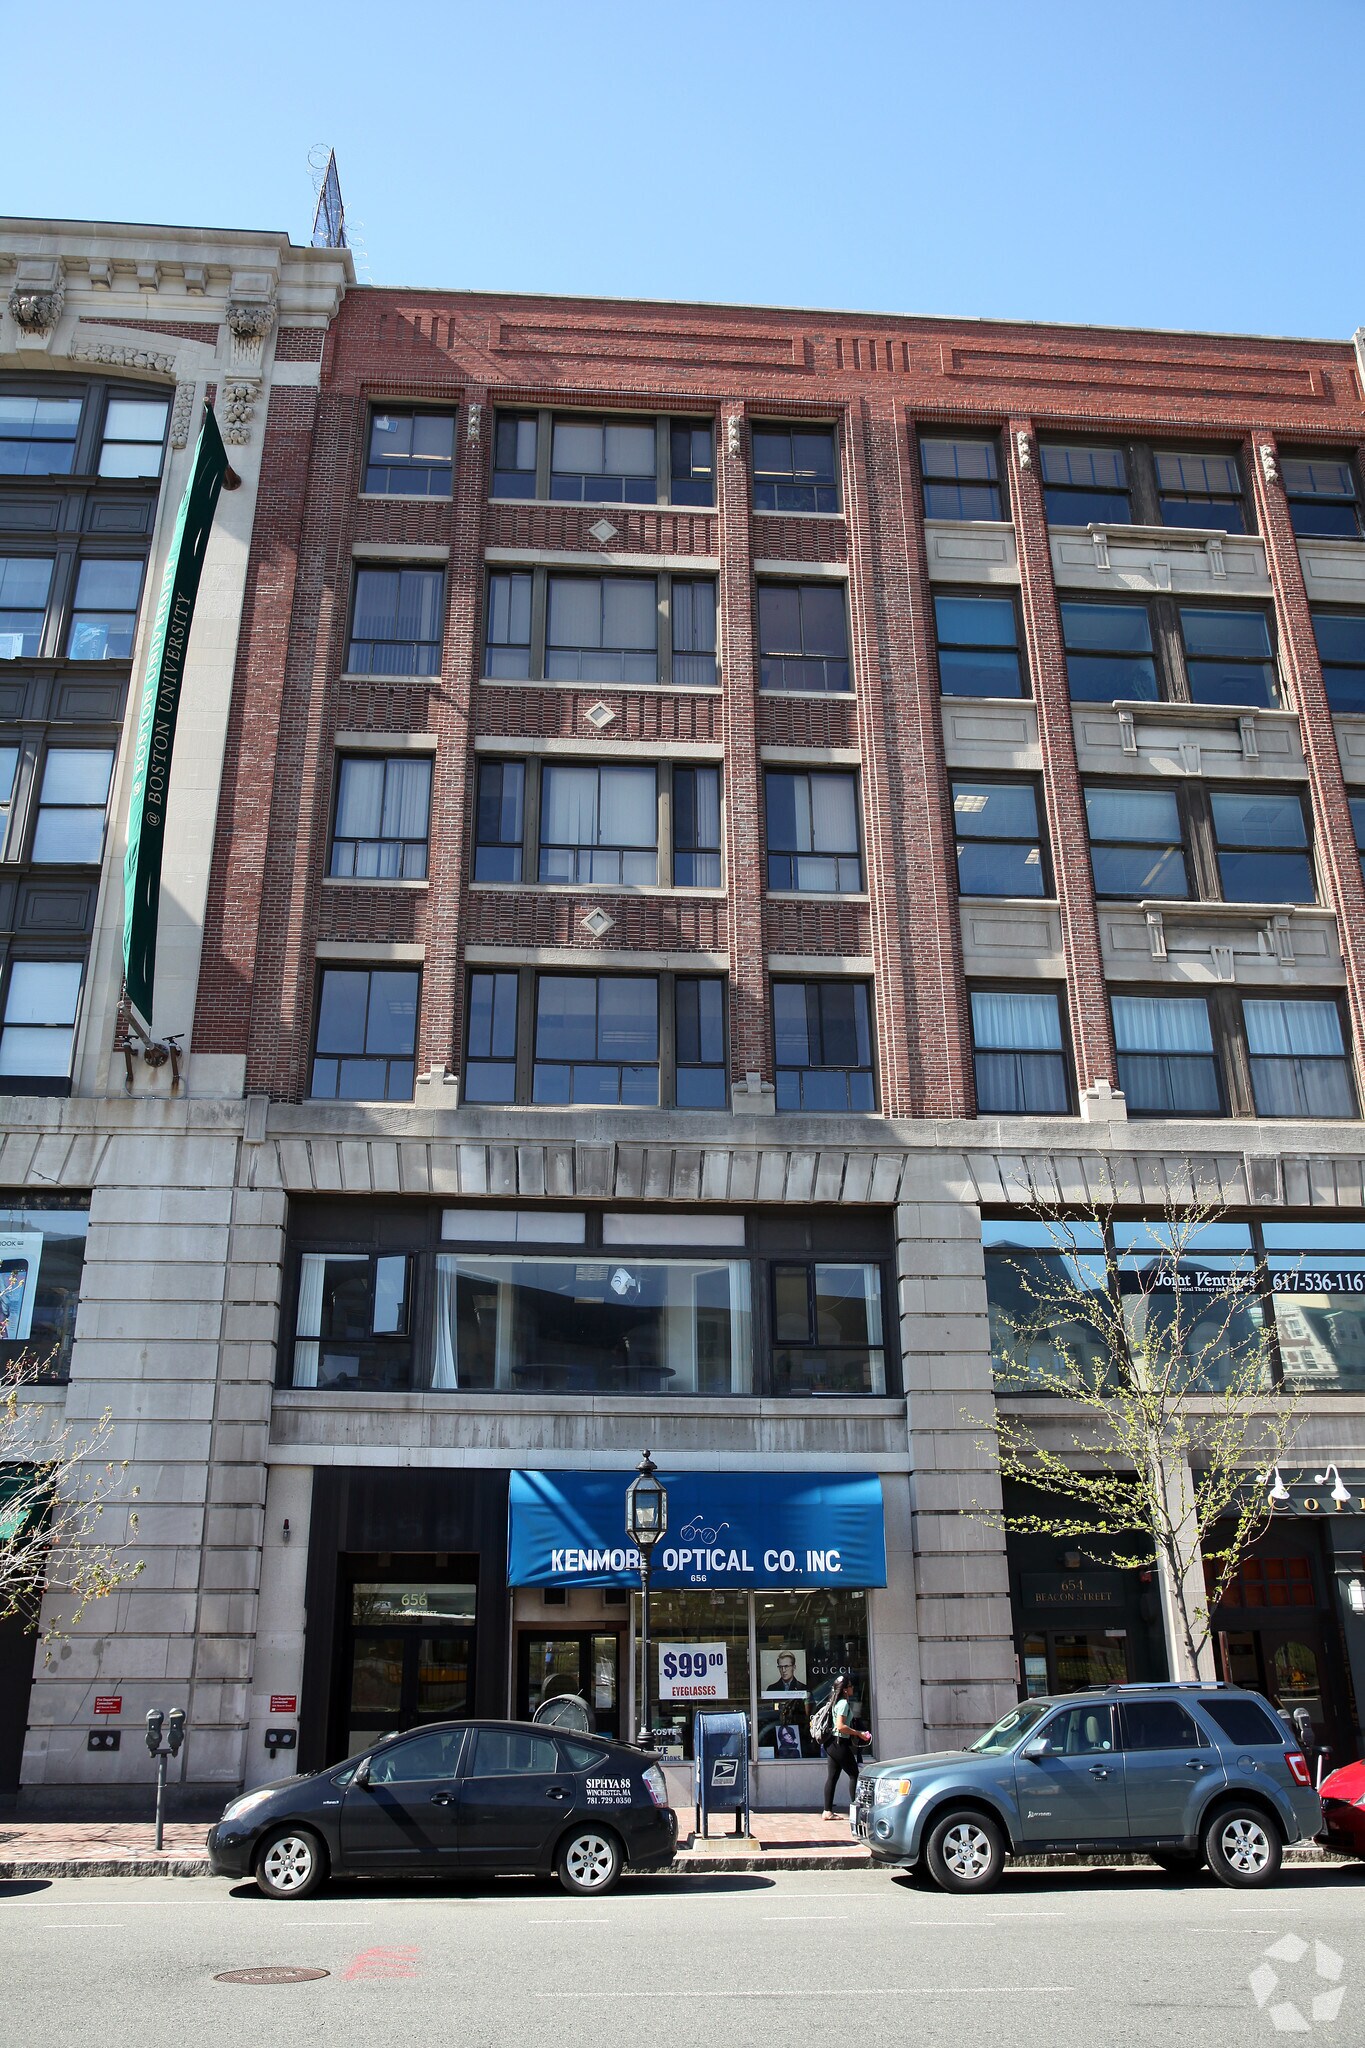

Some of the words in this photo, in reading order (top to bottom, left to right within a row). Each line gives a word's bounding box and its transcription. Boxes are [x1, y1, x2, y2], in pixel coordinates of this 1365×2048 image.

[158, 591, 190, 713] UNIVERSITY
[135, 687, 155, 776] BOSTON
[147, 719, 170, 805] BOSTON
[146, 811, 160, 826] @
[1155, 1271, 1191, 1286] Joint
[1195, 1271, 1256, 1286] Ventures
[551, 1549, 646, 1571] KENMOR
[662, 1549, 754, 1571] OPTICAL
[764, 1550, 803, 1573] CO.,
[806, 1550, 843, 1572] INC.
[690, 1574, 707, 1582] 656
[1061, 1580, 1083, 1590] 654
[401, 1593, 428, 1606] 656
[1035, 1593, 1074, 1601] BEACON
[1077, 1592, 1111, 1600] STREET
[812, 1666, 851, 1674] GUCCI
[672, 1686, 716, 1696] EYEGLASSES
[586, 1778, 620, 1789] SIPHYA
[620, 1778, 631, 1788] 88
